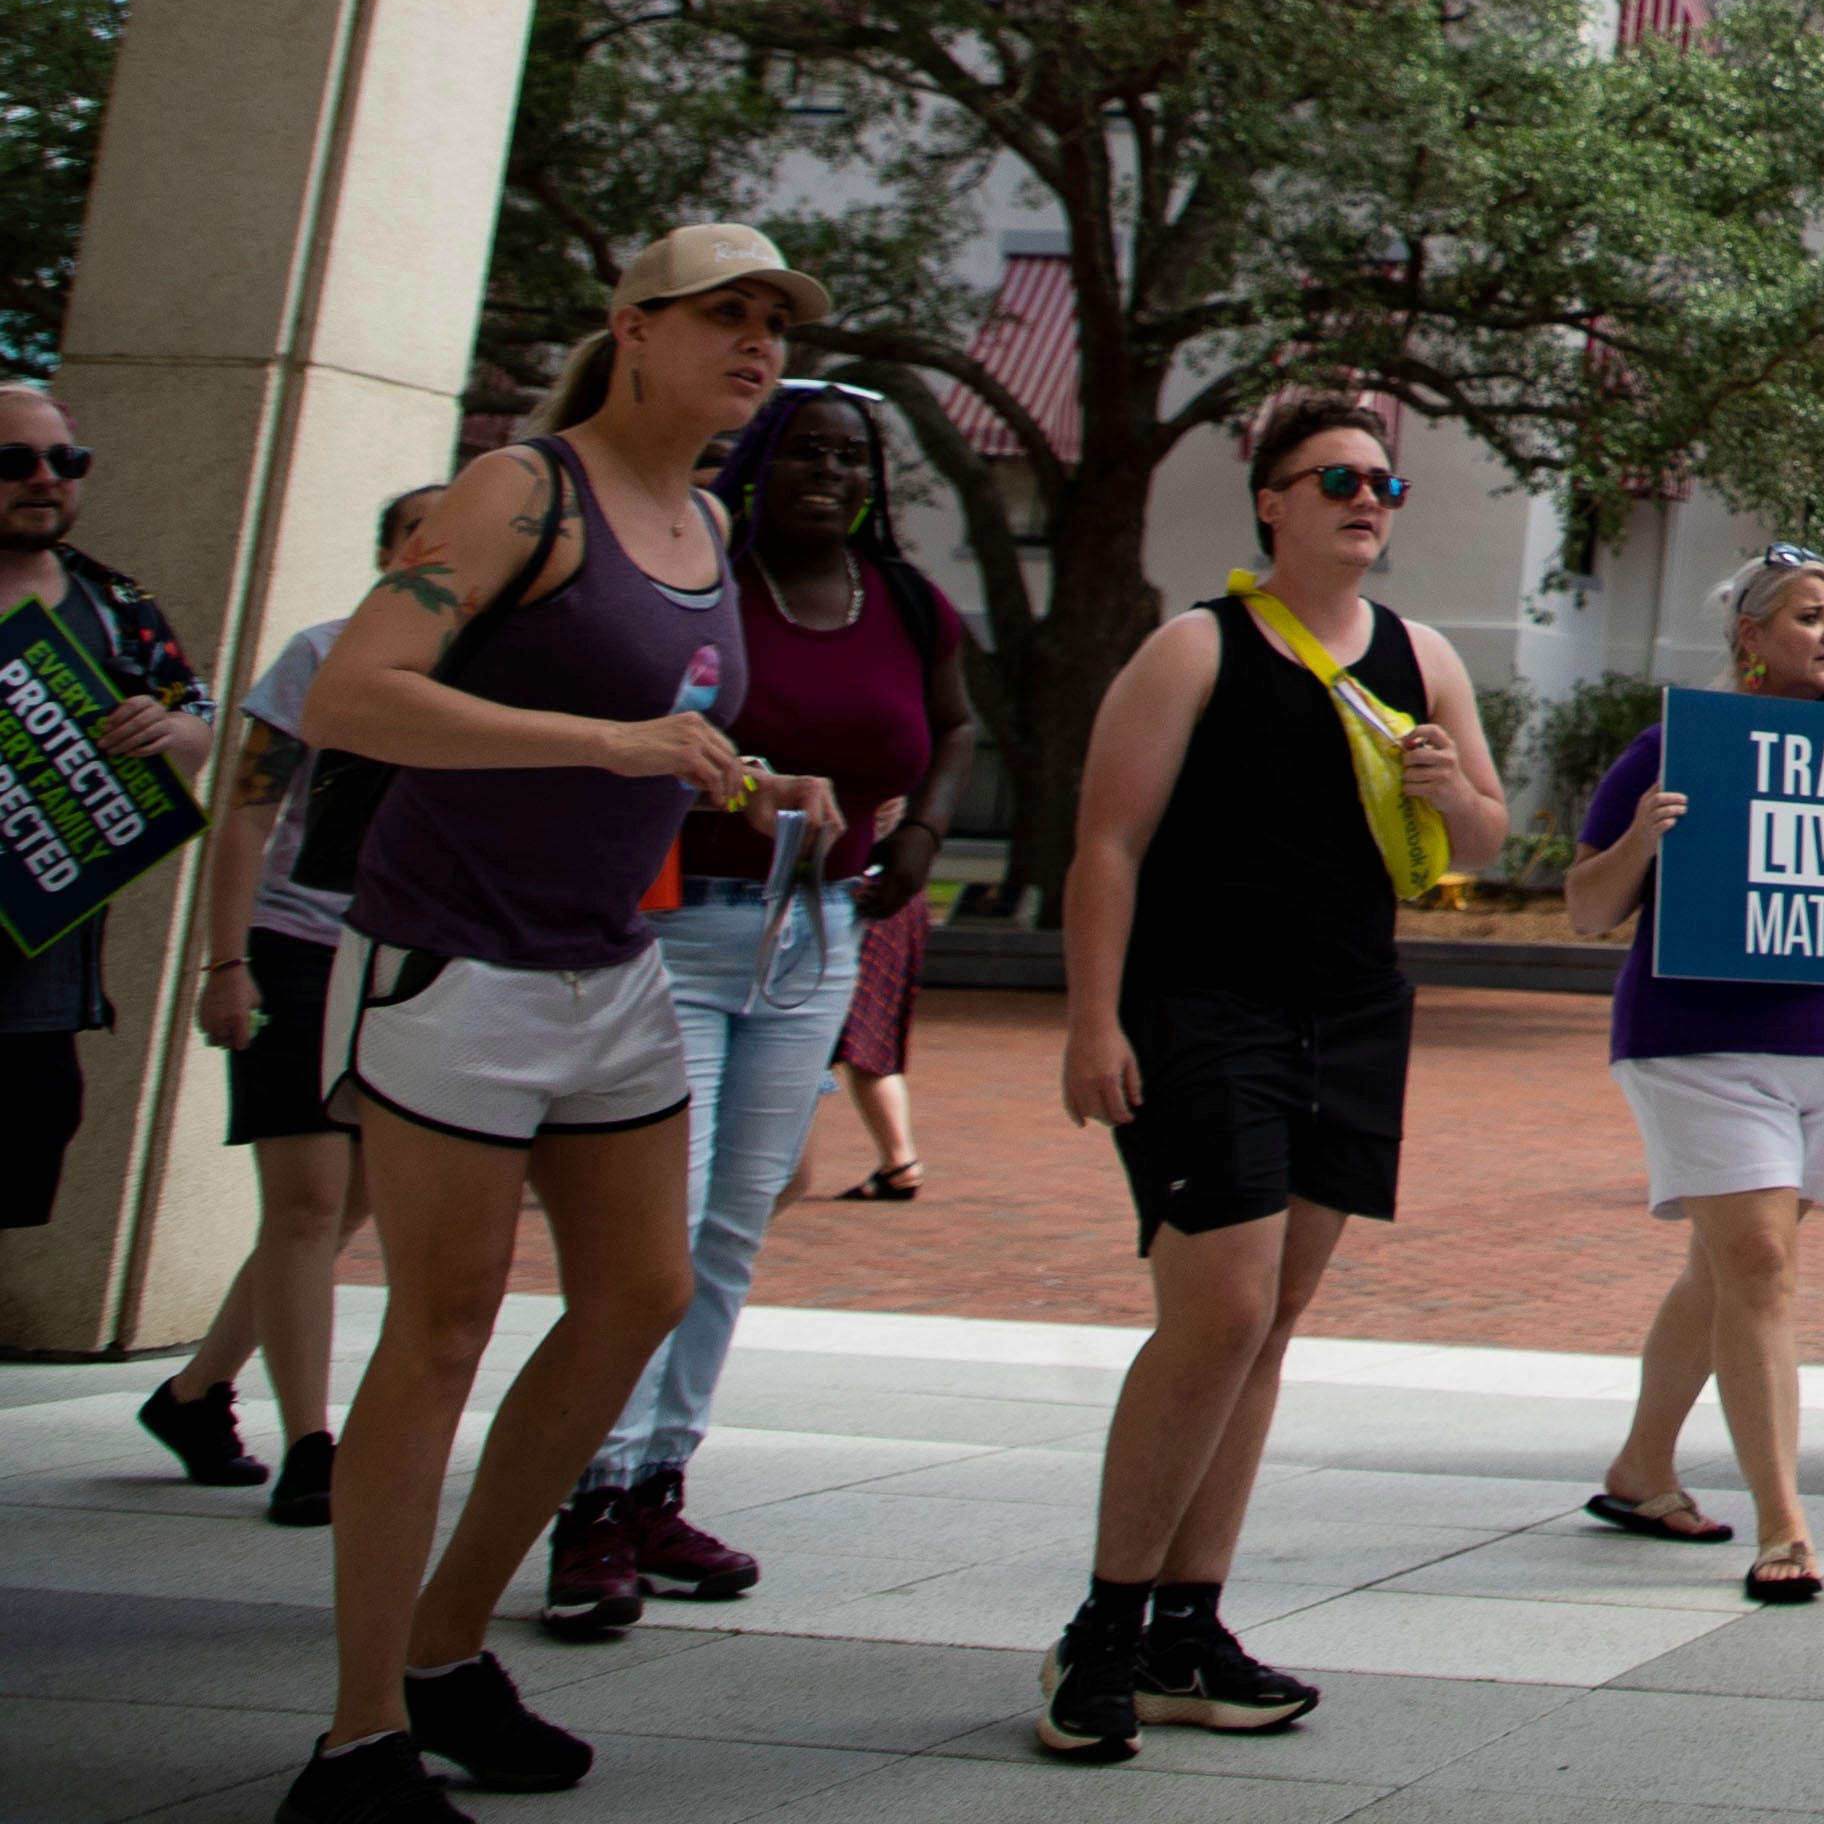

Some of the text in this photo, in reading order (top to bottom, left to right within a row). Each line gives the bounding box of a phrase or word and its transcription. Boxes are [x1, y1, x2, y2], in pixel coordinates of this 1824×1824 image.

[0, 658, 148, 848] PROTECTED
[0, 707, 112, 864] ERY FAMILY
[24, 639, 176, 820] EVERY SDENT
